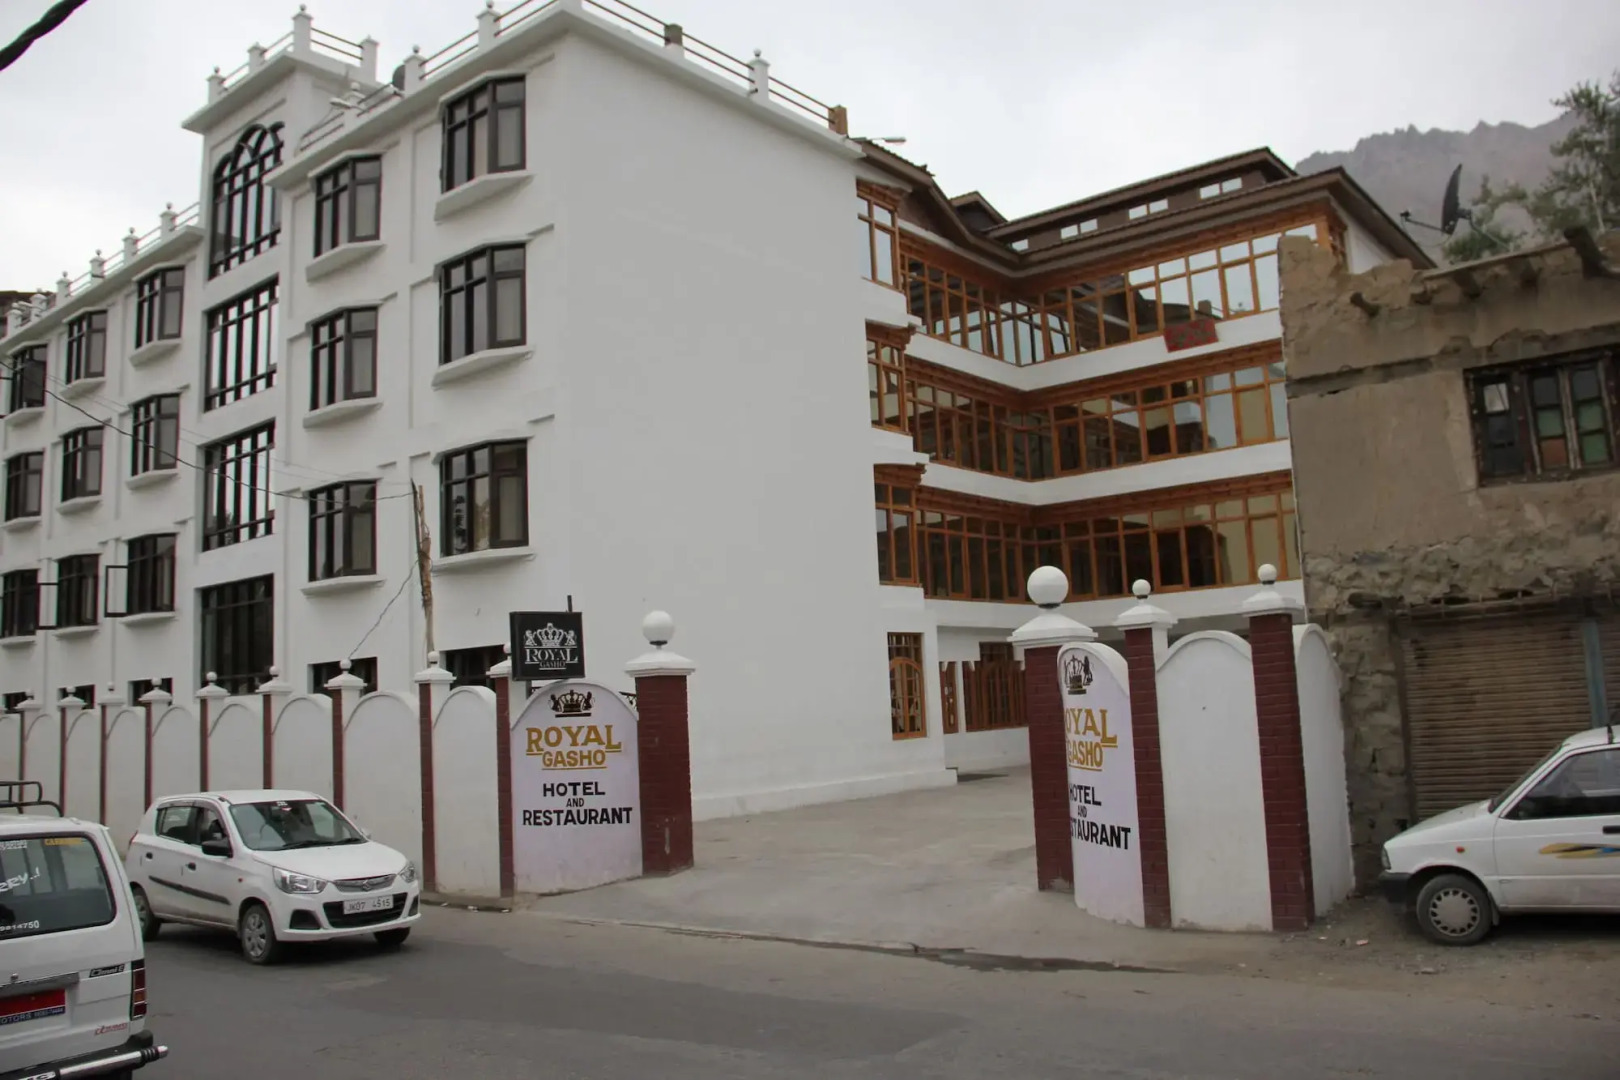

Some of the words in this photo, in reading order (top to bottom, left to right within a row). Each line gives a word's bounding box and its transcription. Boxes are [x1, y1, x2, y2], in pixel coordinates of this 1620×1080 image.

[525, 648, 578, 664] ROYAL
[1065, 708, 1118, 744] OYAL
[526, 724, 622, 753] ROYAL
[542, 749, 606, 767] GASHO
[543, 781, 606, 797] HOTEL
[1069, 783, 1102, 807] HOTEL
[566, 797, 585, 807] AND
[523, 807, 632, 826] RESTAURANT
[1077, 805, 1087, 818] AND
[1070, 817, 1131, 850] TAURANT
